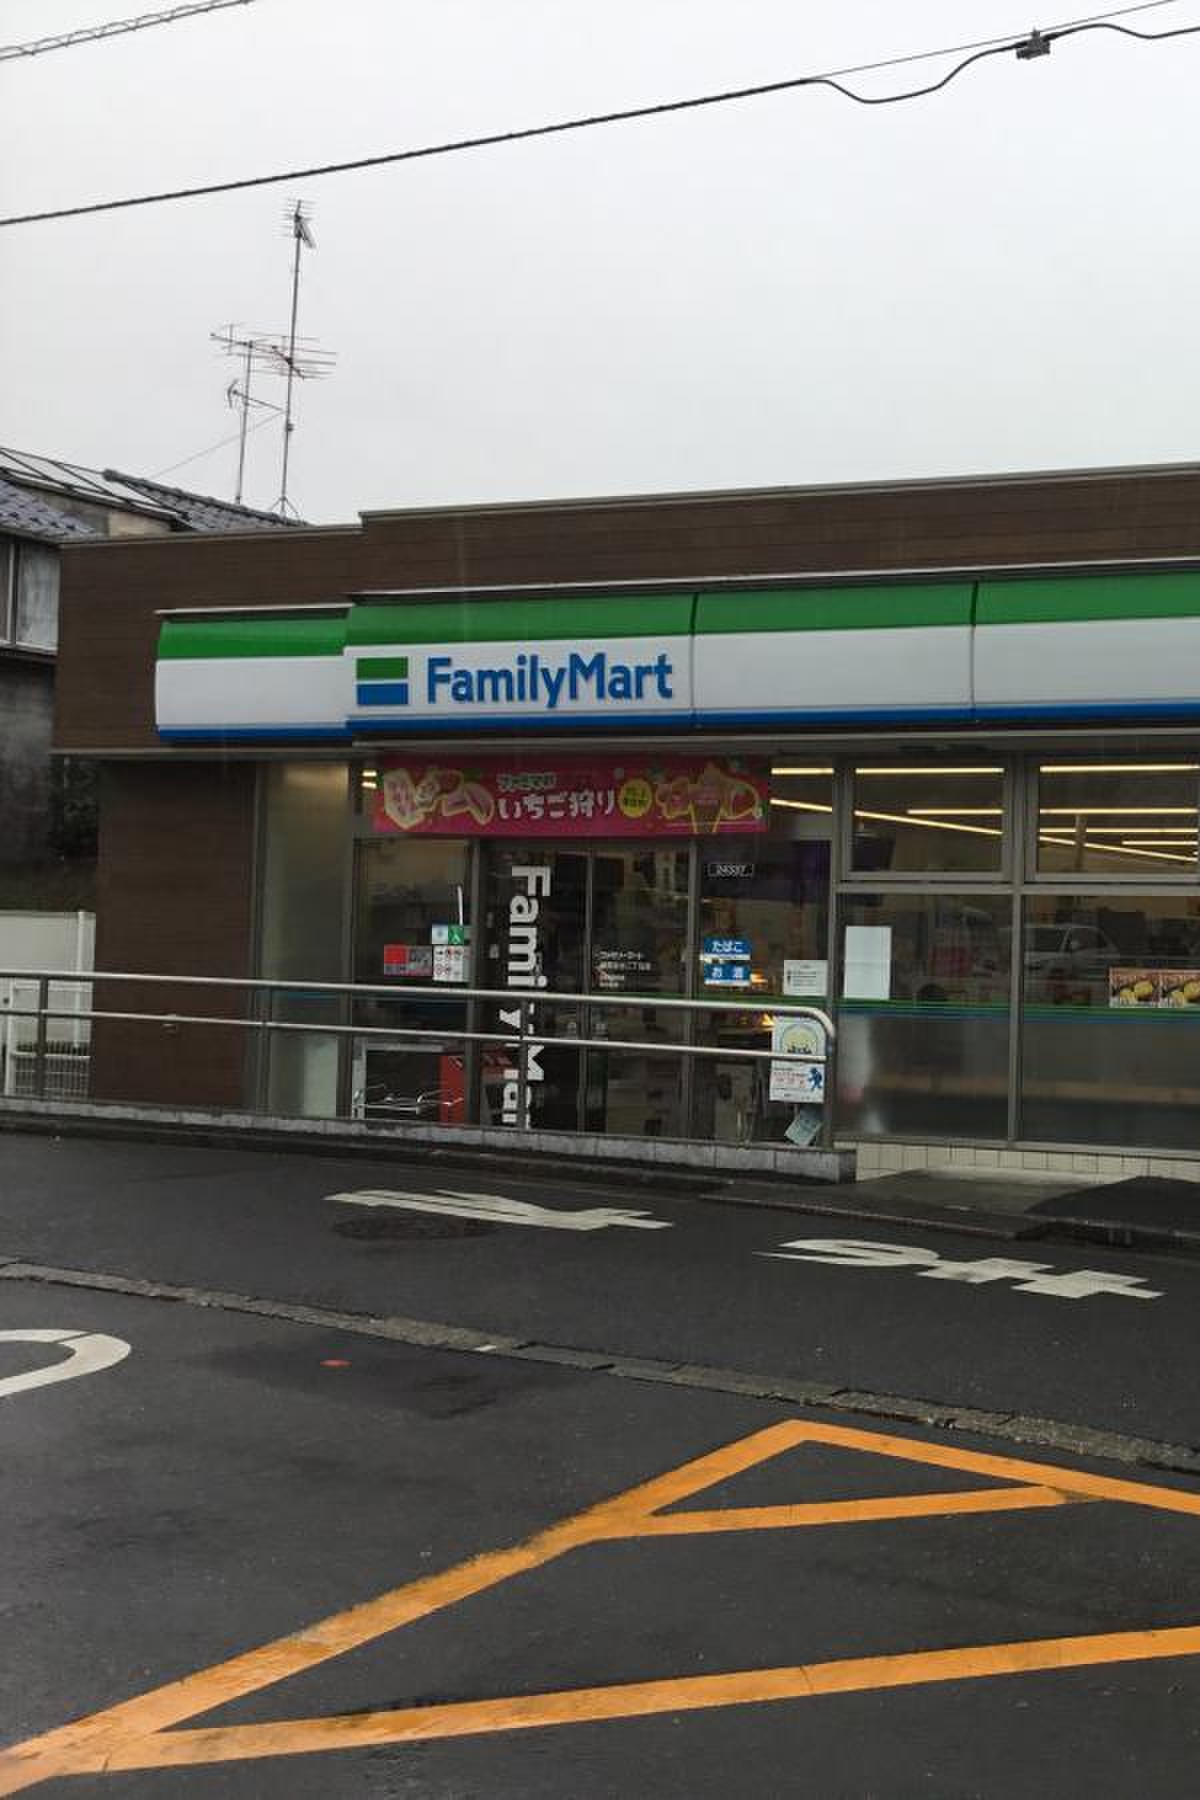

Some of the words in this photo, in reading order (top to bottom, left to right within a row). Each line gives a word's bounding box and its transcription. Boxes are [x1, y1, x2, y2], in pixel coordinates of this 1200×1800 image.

[427, 652, 673, 708] FamilyMart
[497, 788, 615, 819] いちご狩り
